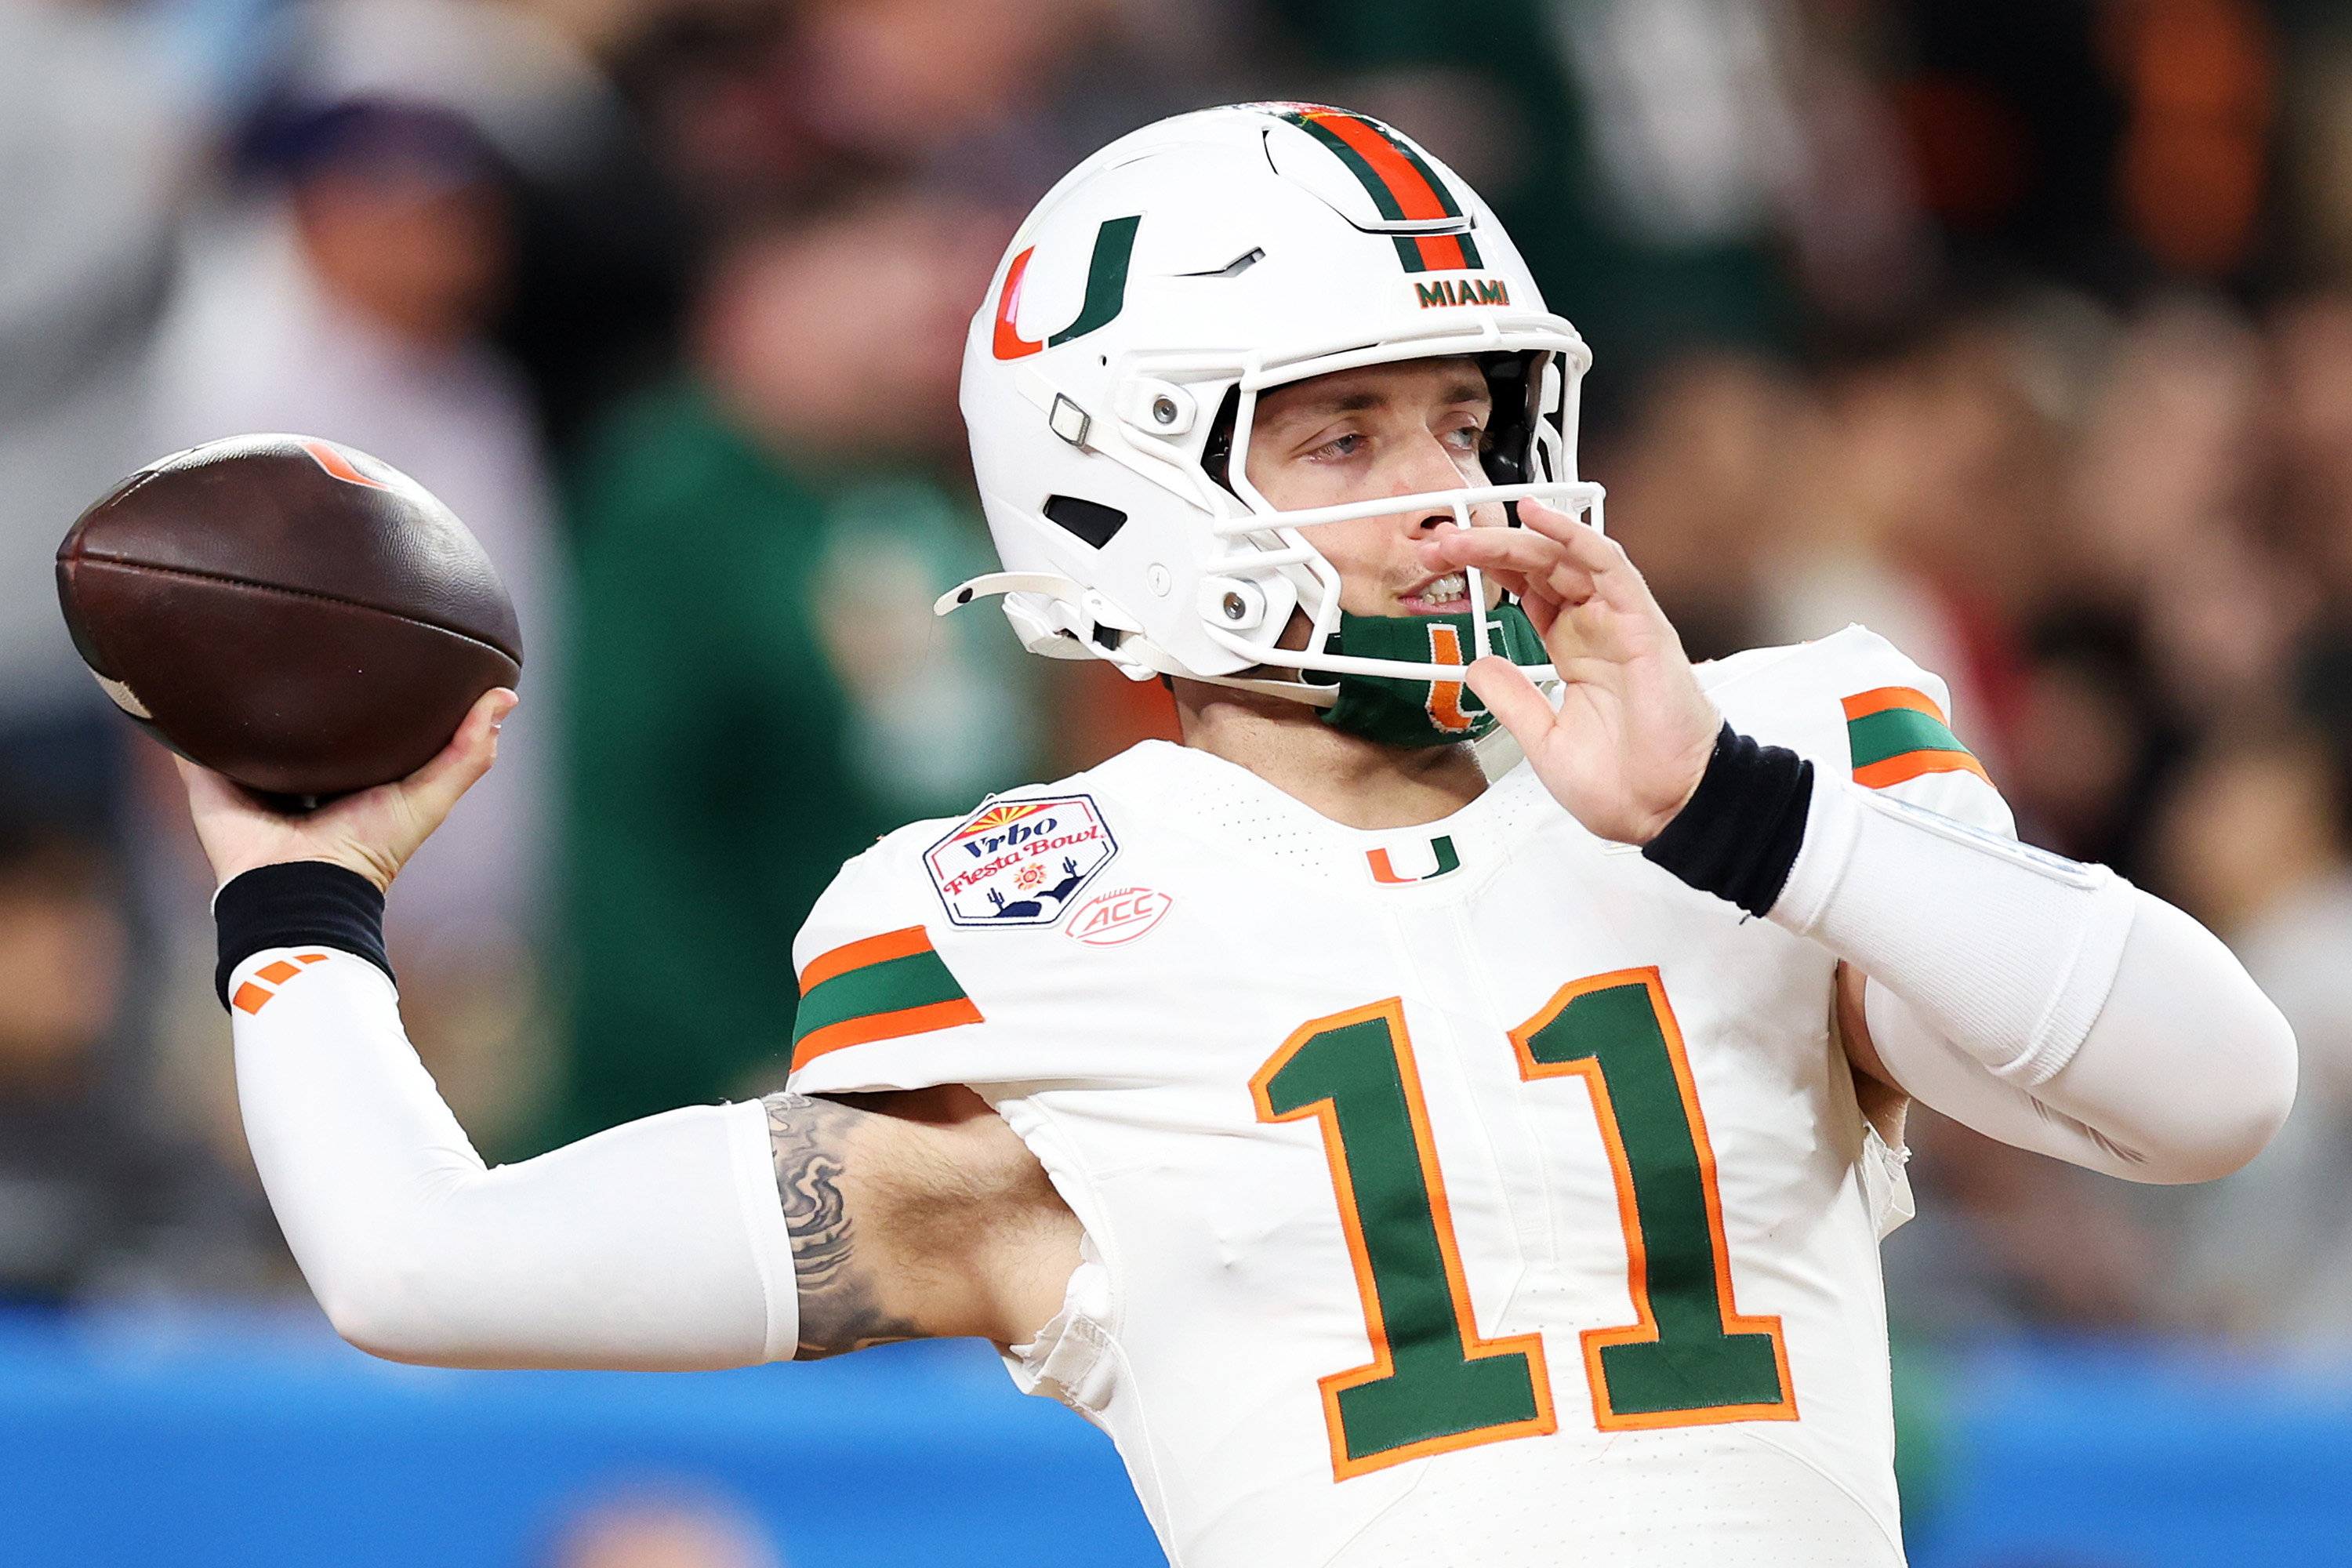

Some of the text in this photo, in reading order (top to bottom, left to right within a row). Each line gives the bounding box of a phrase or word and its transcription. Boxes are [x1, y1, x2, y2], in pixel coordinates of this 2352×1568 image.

[992, 213, 1144, 361] U
[1414, 278, 1510, 309] MIAMI
[943, 825, 1099, 895] Fiesta Bowl
[964, 818, 1058, 858] Vrbo
[1365, 834, 1461, 884] U
[1083, 892, 1154, 931] ACC
[1247, 965, 1800, 1483] 11
